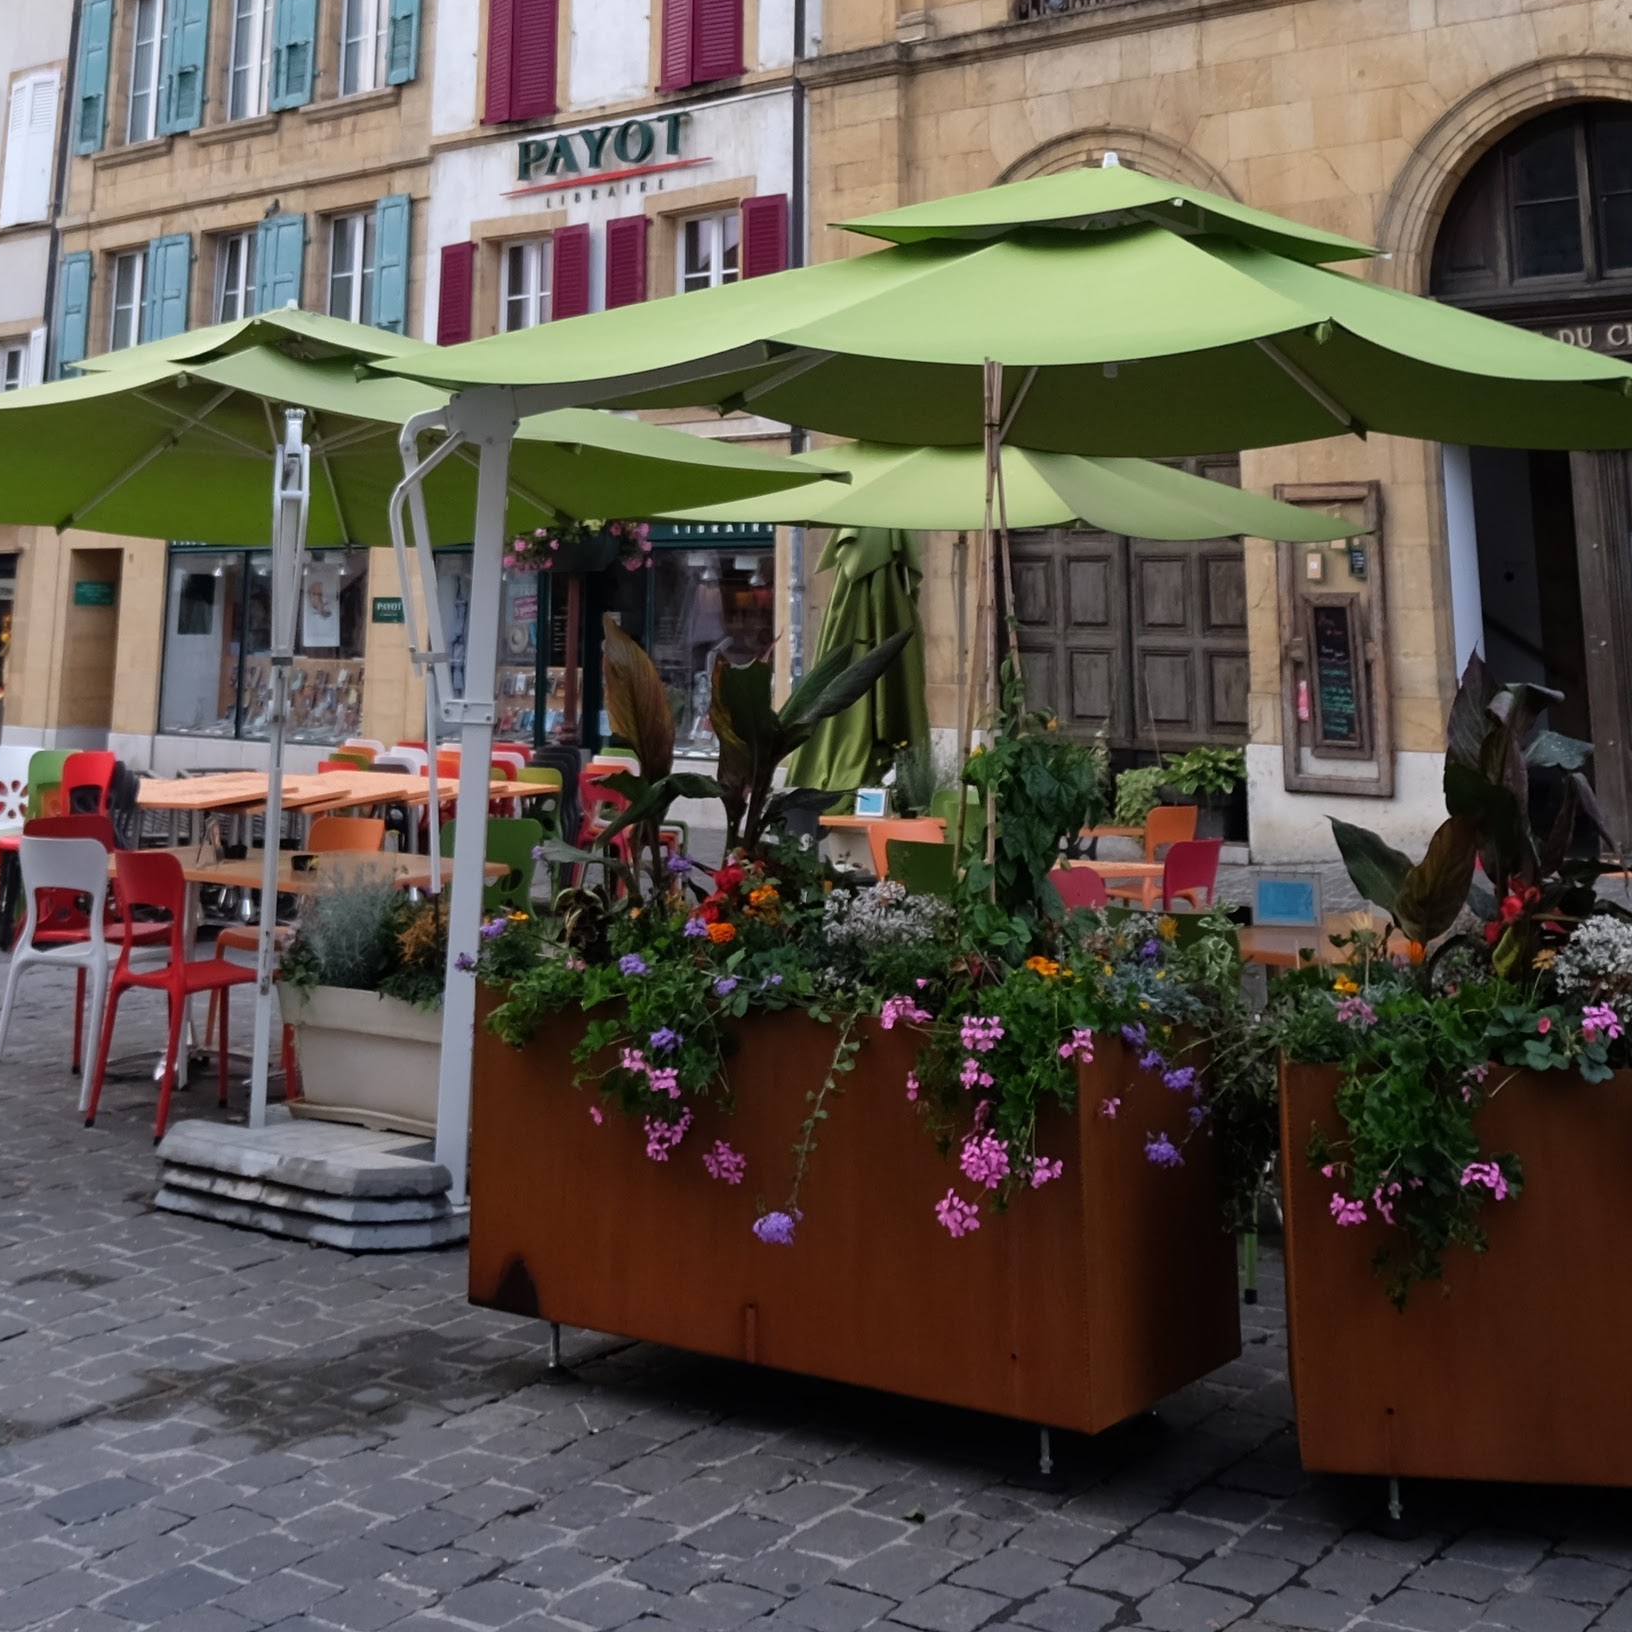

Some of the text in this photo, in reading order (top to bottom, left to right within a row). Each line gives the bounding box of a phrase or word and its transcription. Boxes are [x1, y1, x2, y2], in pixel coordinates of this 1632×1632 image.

[516, 111, 693, 181] PAYOT
[546, 178, 665, 209] LIBRAIRE
[1558, 326, 1593, 348] DU
[377, 601, 402, 611] PAYOT
